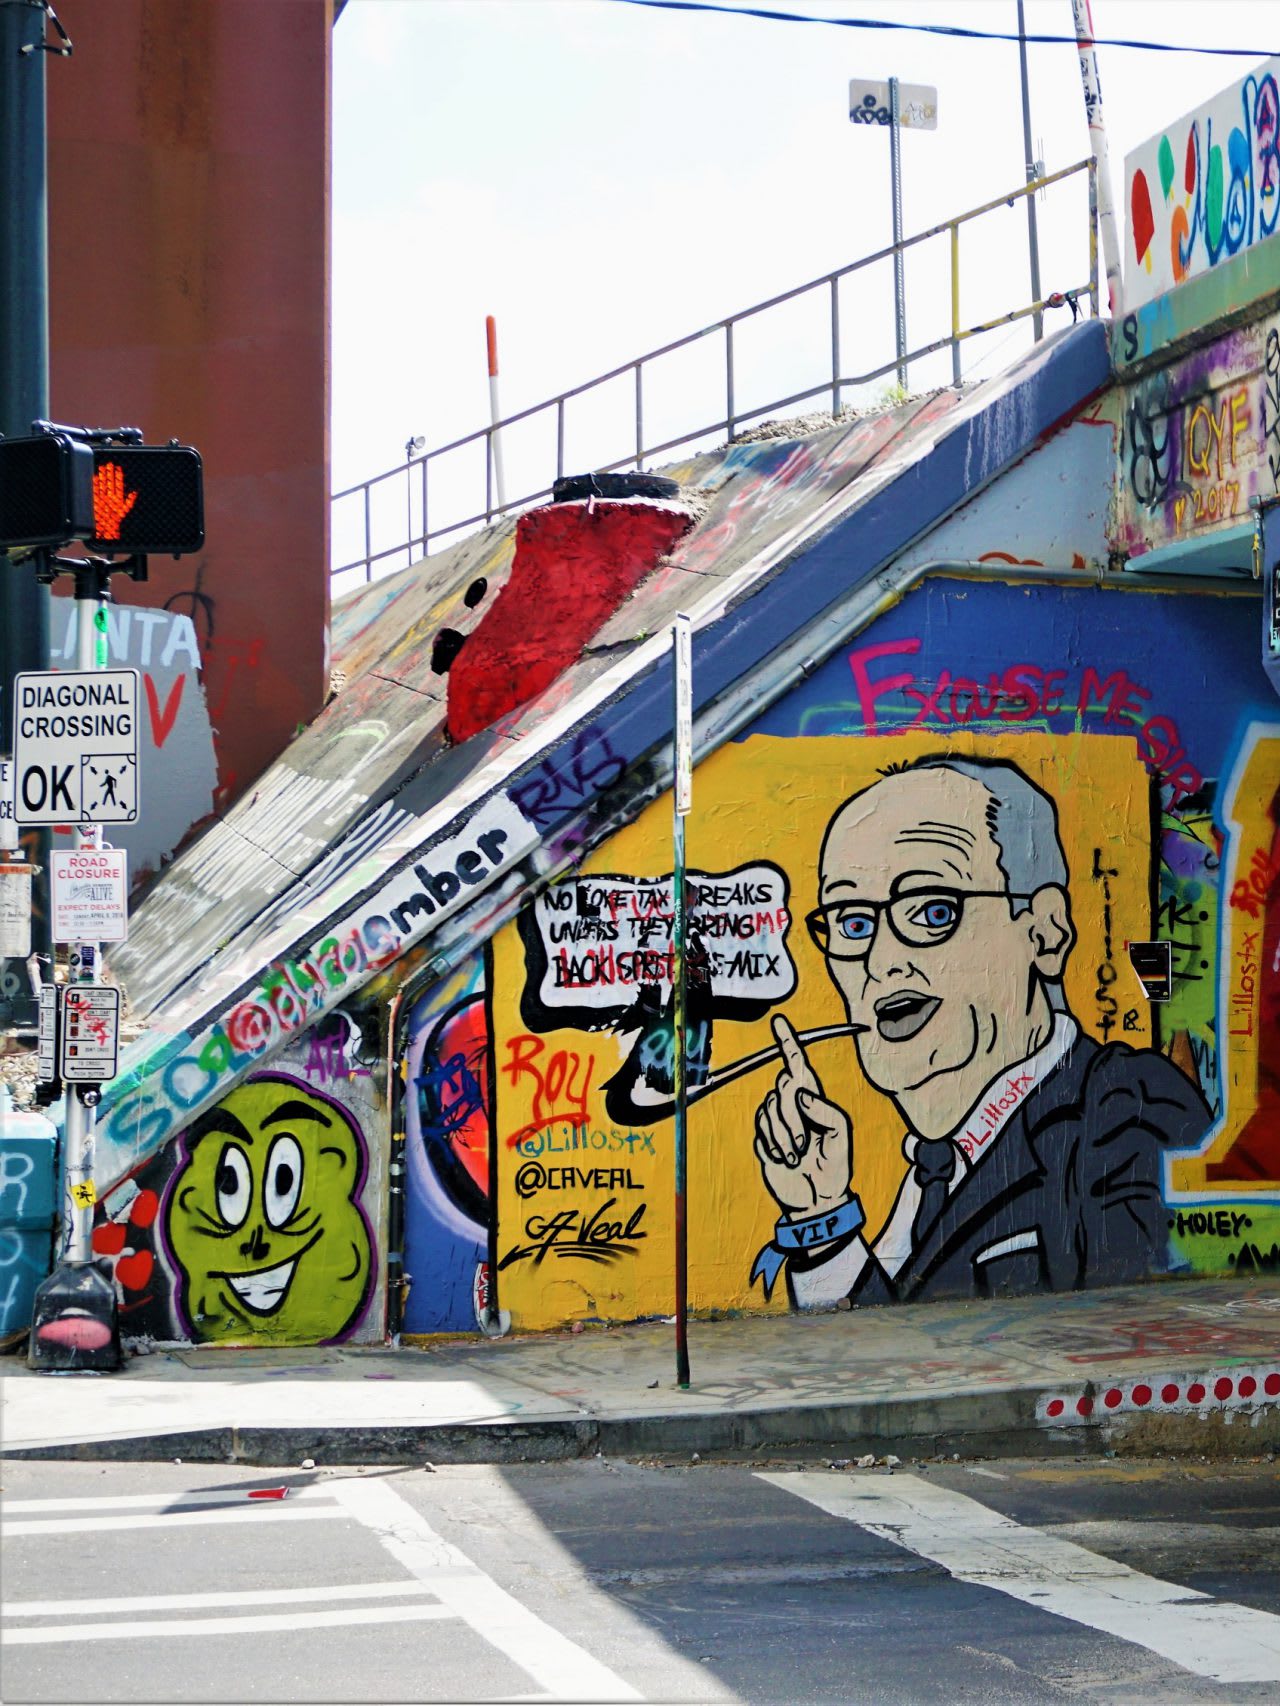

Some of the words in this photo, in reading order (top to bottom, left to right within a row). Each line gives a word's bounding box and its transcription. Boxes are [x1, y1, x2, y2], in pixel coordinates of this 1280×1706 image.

[22, 683, 130, 708] DIAGONAL
[20, 714, 131, 739] CROSSING
[21, 764, 76, 812] OK
[57, 869, 120, 879] CLOSURE
[69, 857, 108, 867] ROAD
[543, 890, 573, 911] NO
[589, 887, 635, 909] OKE
[698, 883, 773, 907] REAKS
[791, 1215, 839, 1246] VIP
